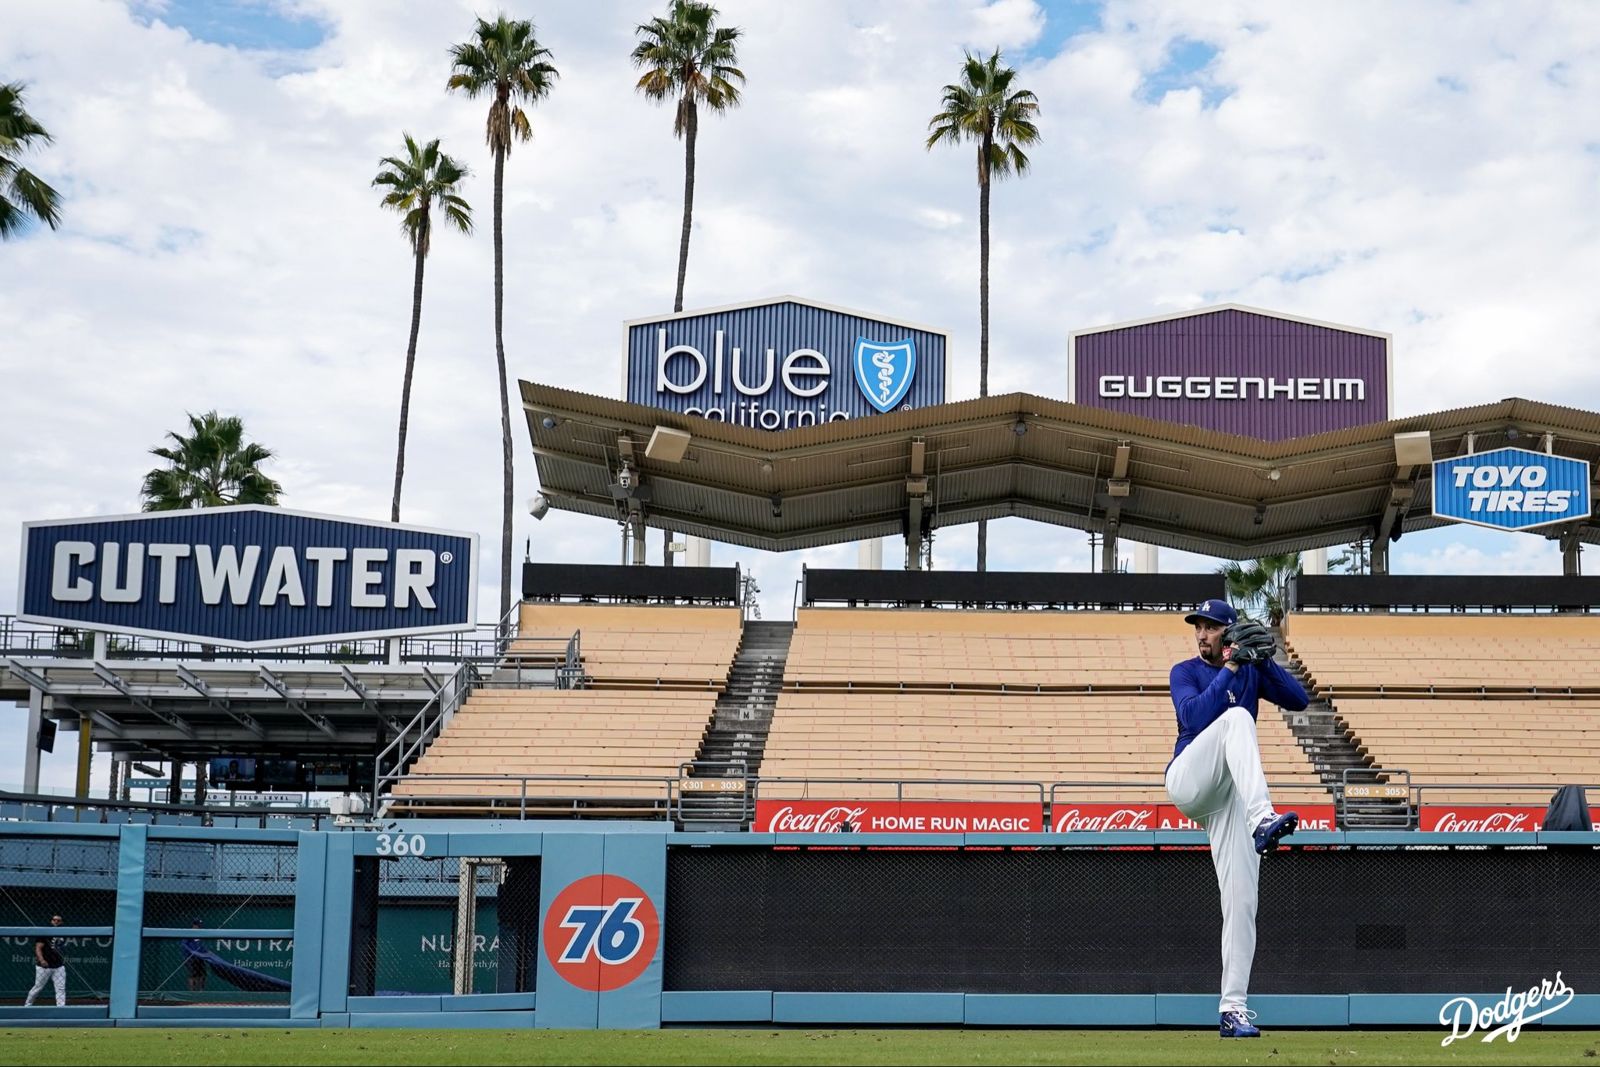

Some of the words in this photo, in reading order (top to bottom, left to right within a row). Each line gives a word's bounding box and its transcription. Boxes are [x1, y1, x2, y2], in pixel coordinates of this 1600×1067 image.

[657, 329, 830, 397] blue
[1100, 376, 1364, 400] GUGGENHEIM
[1453, 466, 1547, 488] TOYO
[689, 781, 704, 790] 301
[720, 781, 737, 790] 303
[872, 817, 925, 830] HOME
[931, 817, 967, 831] RUN
[973, 817, 1030, 831] MAGIC
[375, 834, 426, 856] 360
[558, 897, 645, 965] 76
